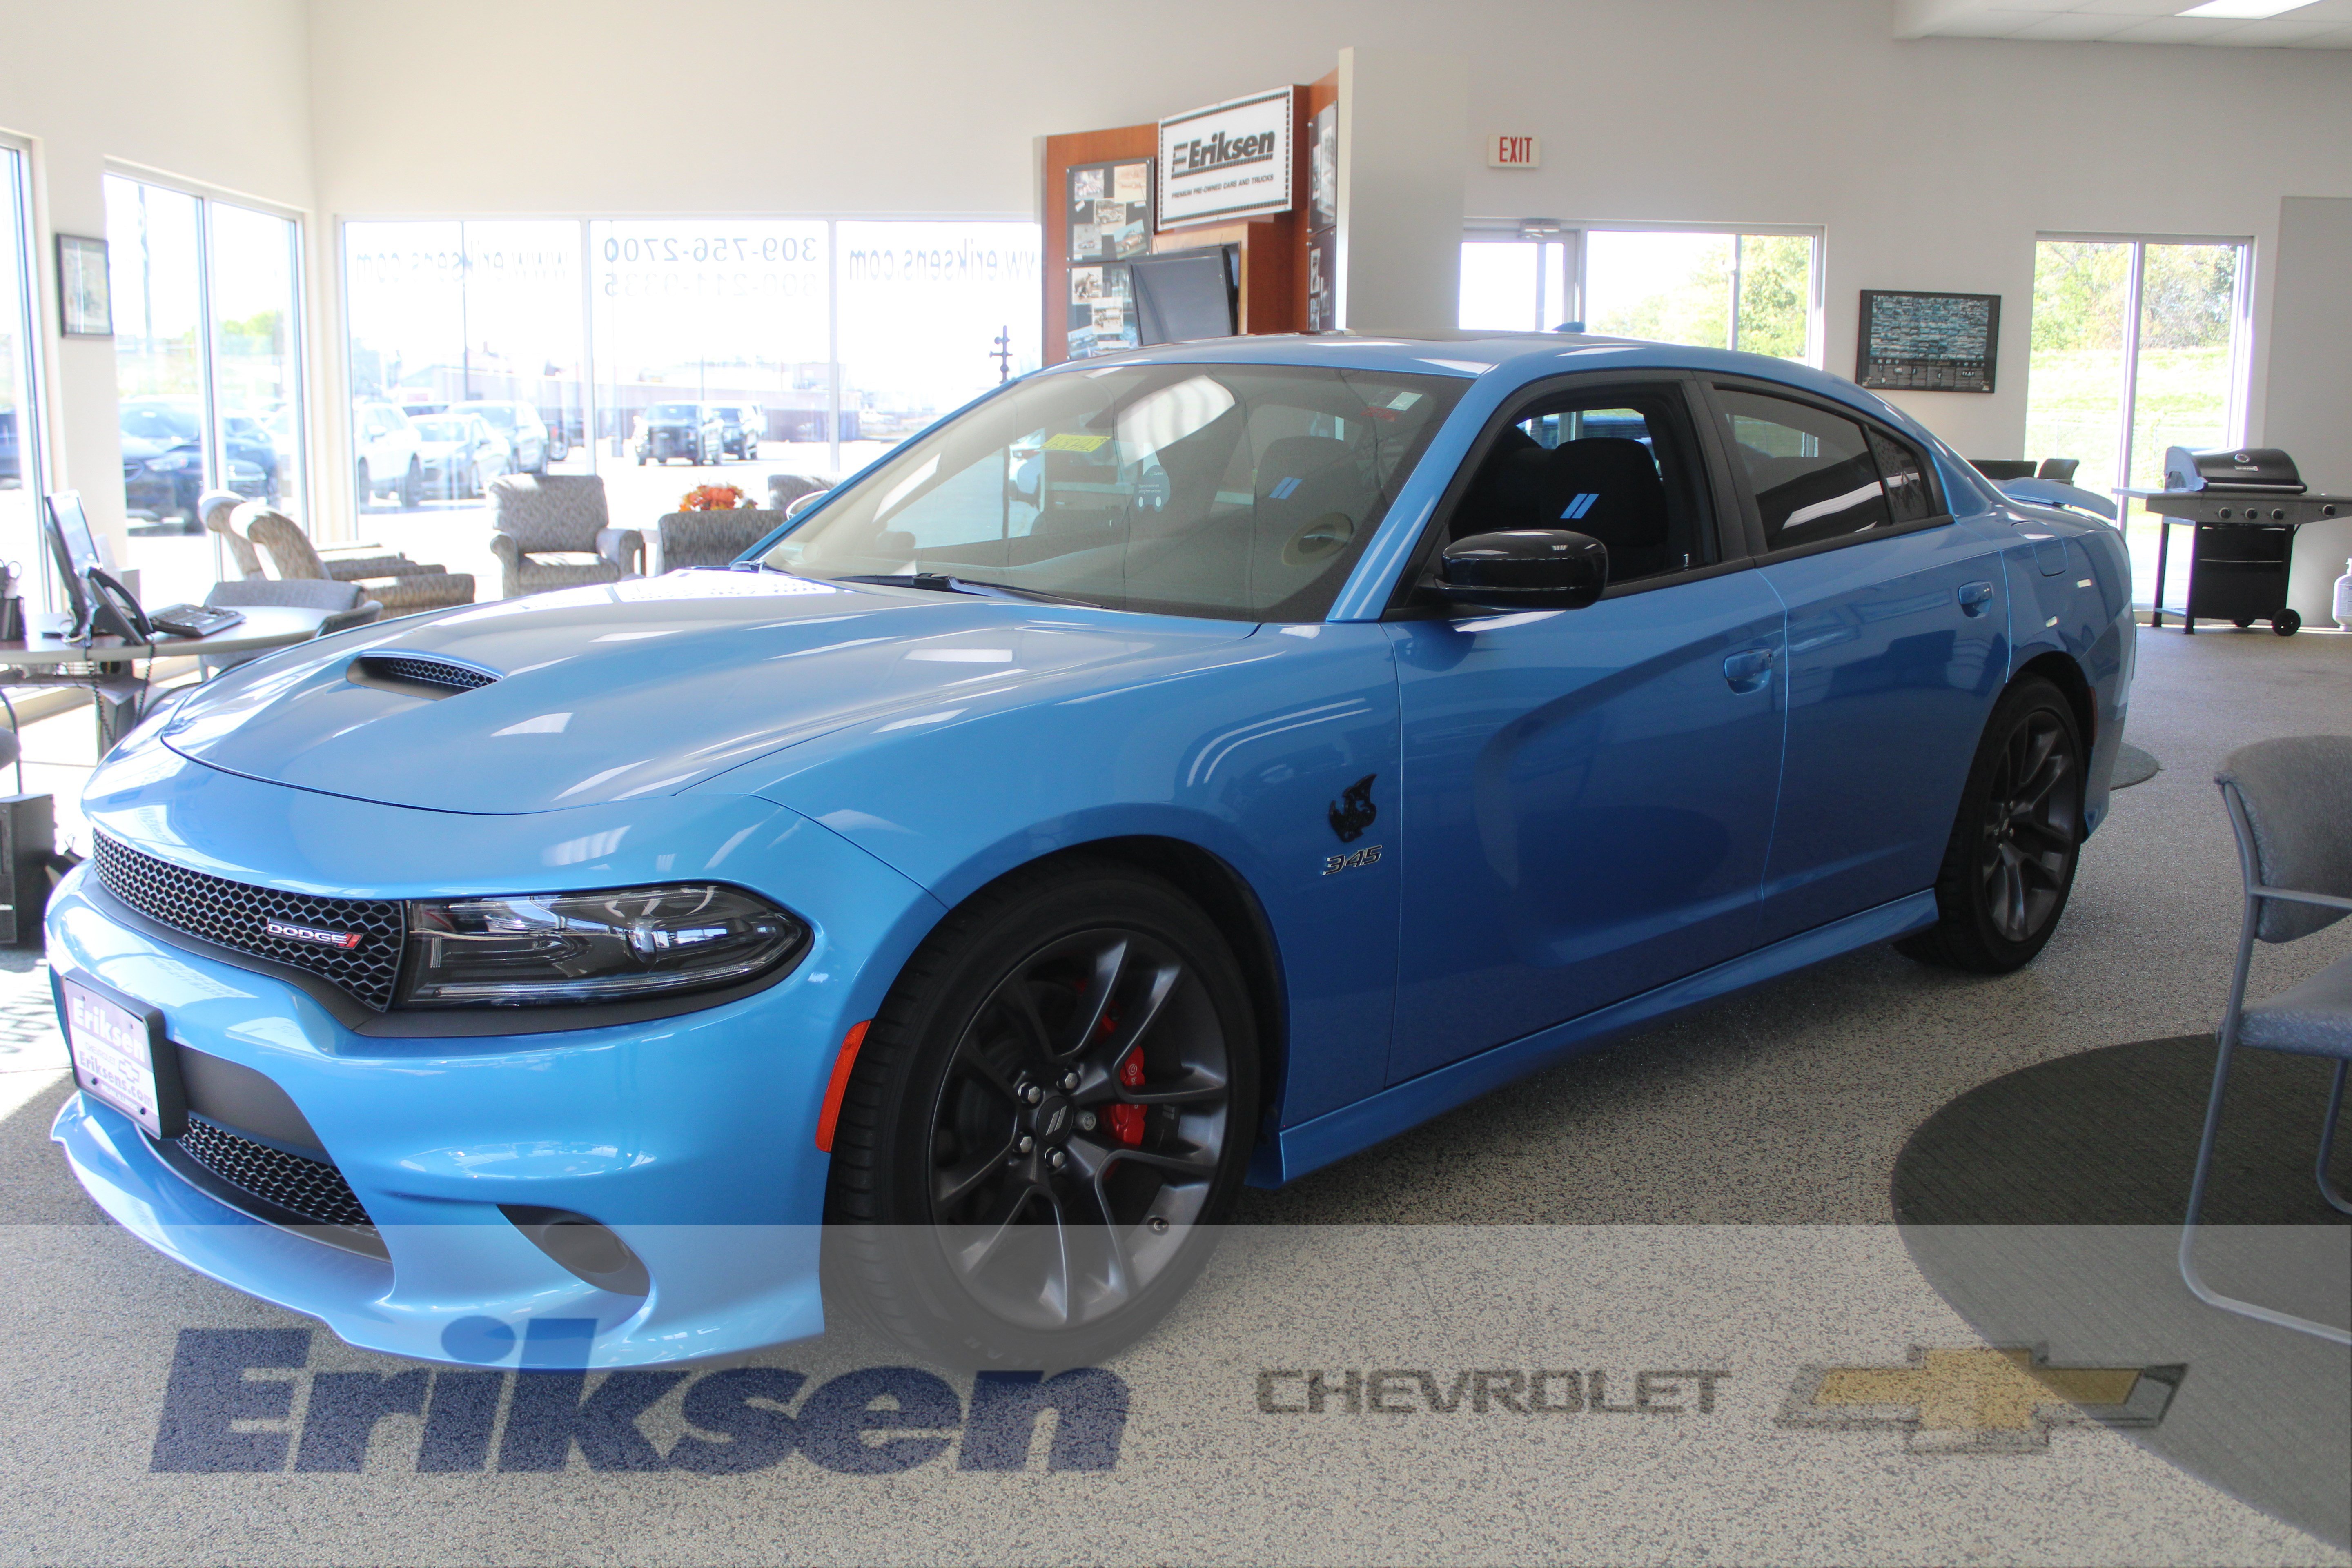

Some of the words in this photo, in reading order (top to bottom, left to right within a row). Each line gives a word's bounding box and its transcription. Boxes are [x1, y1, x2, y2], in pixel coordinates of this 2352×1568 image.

[1189, 130, 1275, 169] Eriksen
[1499, 136, 1533, 163] EXIT
[1172, 189, 1192, 199] PREMIUM
[1193, 183, 1222, 194] PRE-OWNED
[1223, 180, 1237, 189] CARS
[1238, 178, 1250, 186] AND
[1251, 174, 1274, 184] TRUCKS
[1322, 844, 1383, 876] 345
[268, 924, 348, 944] DODGE
[73, 996, 146, 1063] Eriksen
[80, 1050, 154, 1109] Eriksens.com
